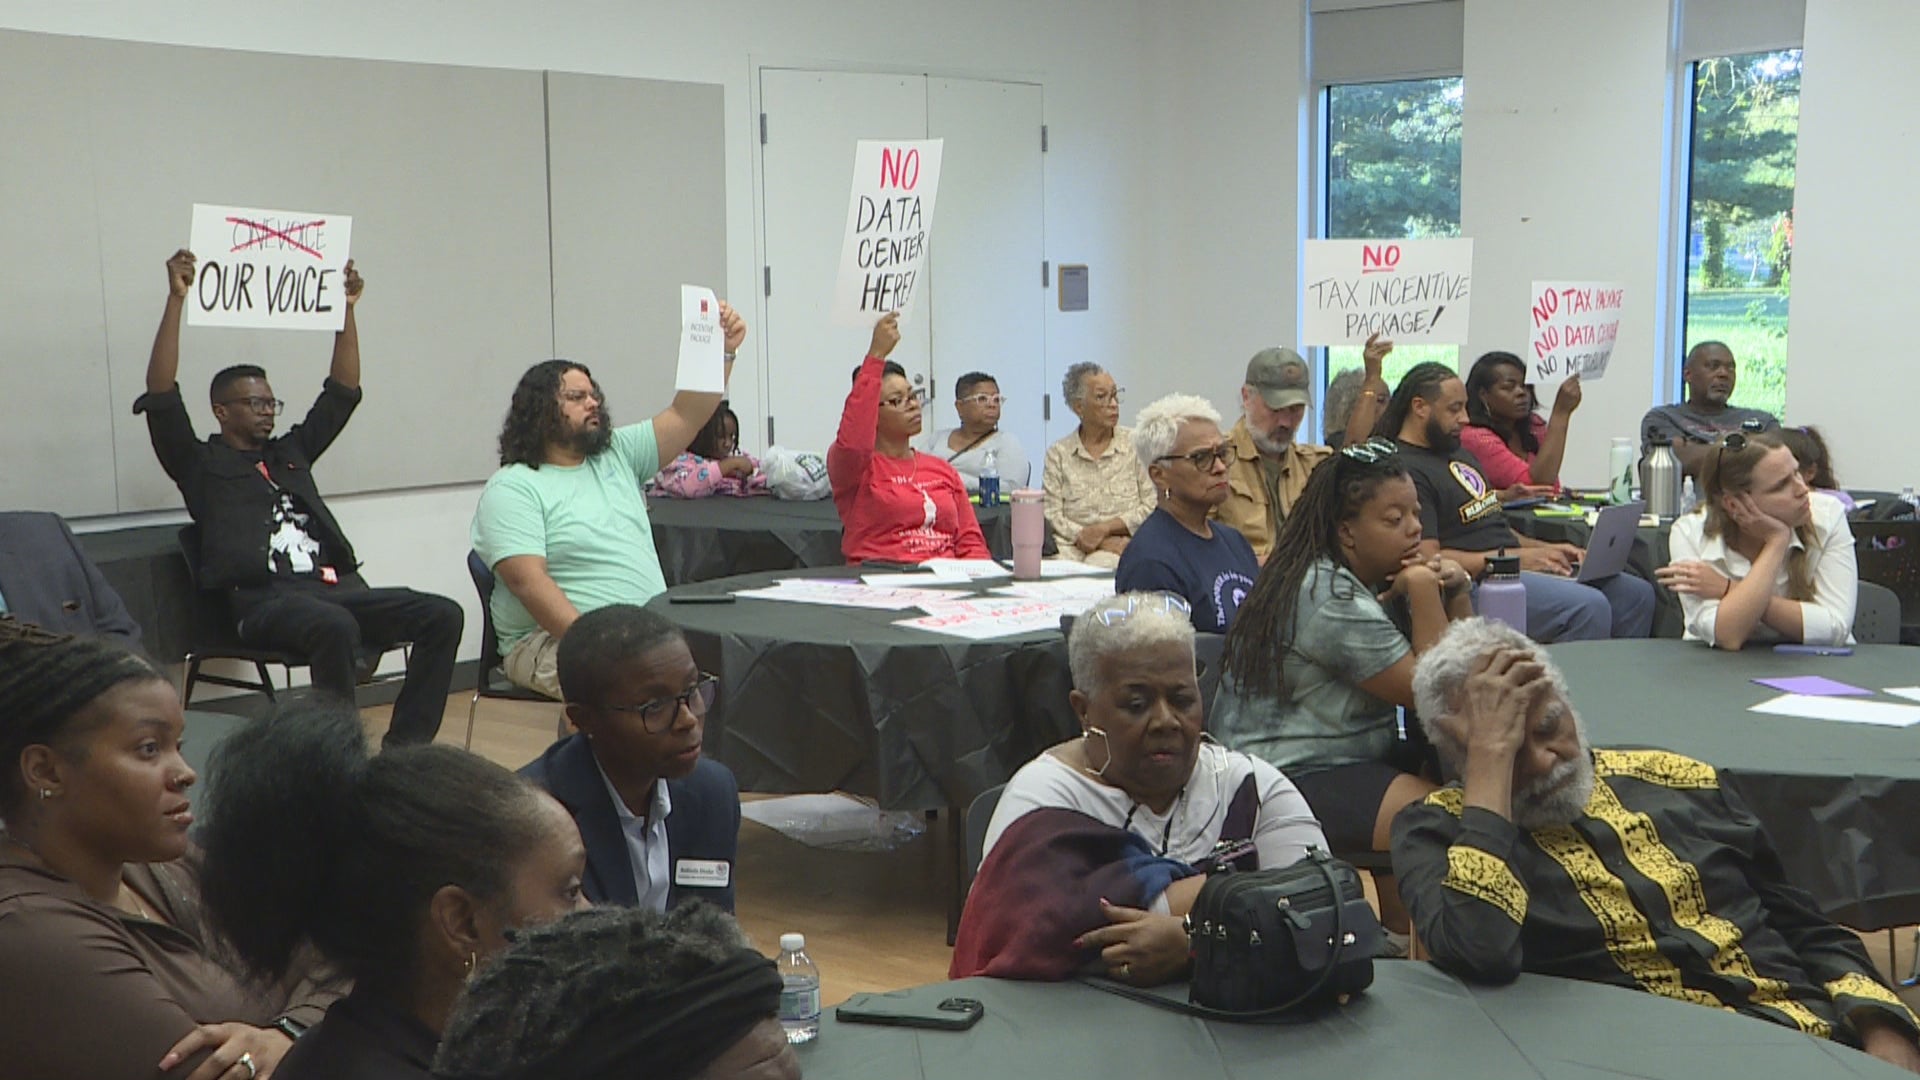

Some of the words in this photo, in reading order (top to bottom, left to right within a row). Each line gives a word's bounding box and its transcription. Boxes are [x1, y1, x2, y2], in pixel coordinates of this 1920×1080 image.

[879, 146, 920, 190] NO
[856, 195, 922, 234] DATA
[858, 230, 925, 269] CENTER
[1362, 244, 1401, 267] NO
[198, 261, 255, 312] OUR
[265, 263, 337, 317] VOICE
[859, 269, 917, 313] HERE!
[1308, 277, 1360, 310] TAX
[1369, 272, 1471, 307] INCENTIVE
[1532, 287, 1558, 329] NO
[1562, 287, 1592, 315] TAX
[1345, 305, 1446, 338] PACKAGE!
[1534, 325, 1559, 359] NO
[1565, 325, 1595, 348] DATA
[1536, 355, 1558, 380] NO
